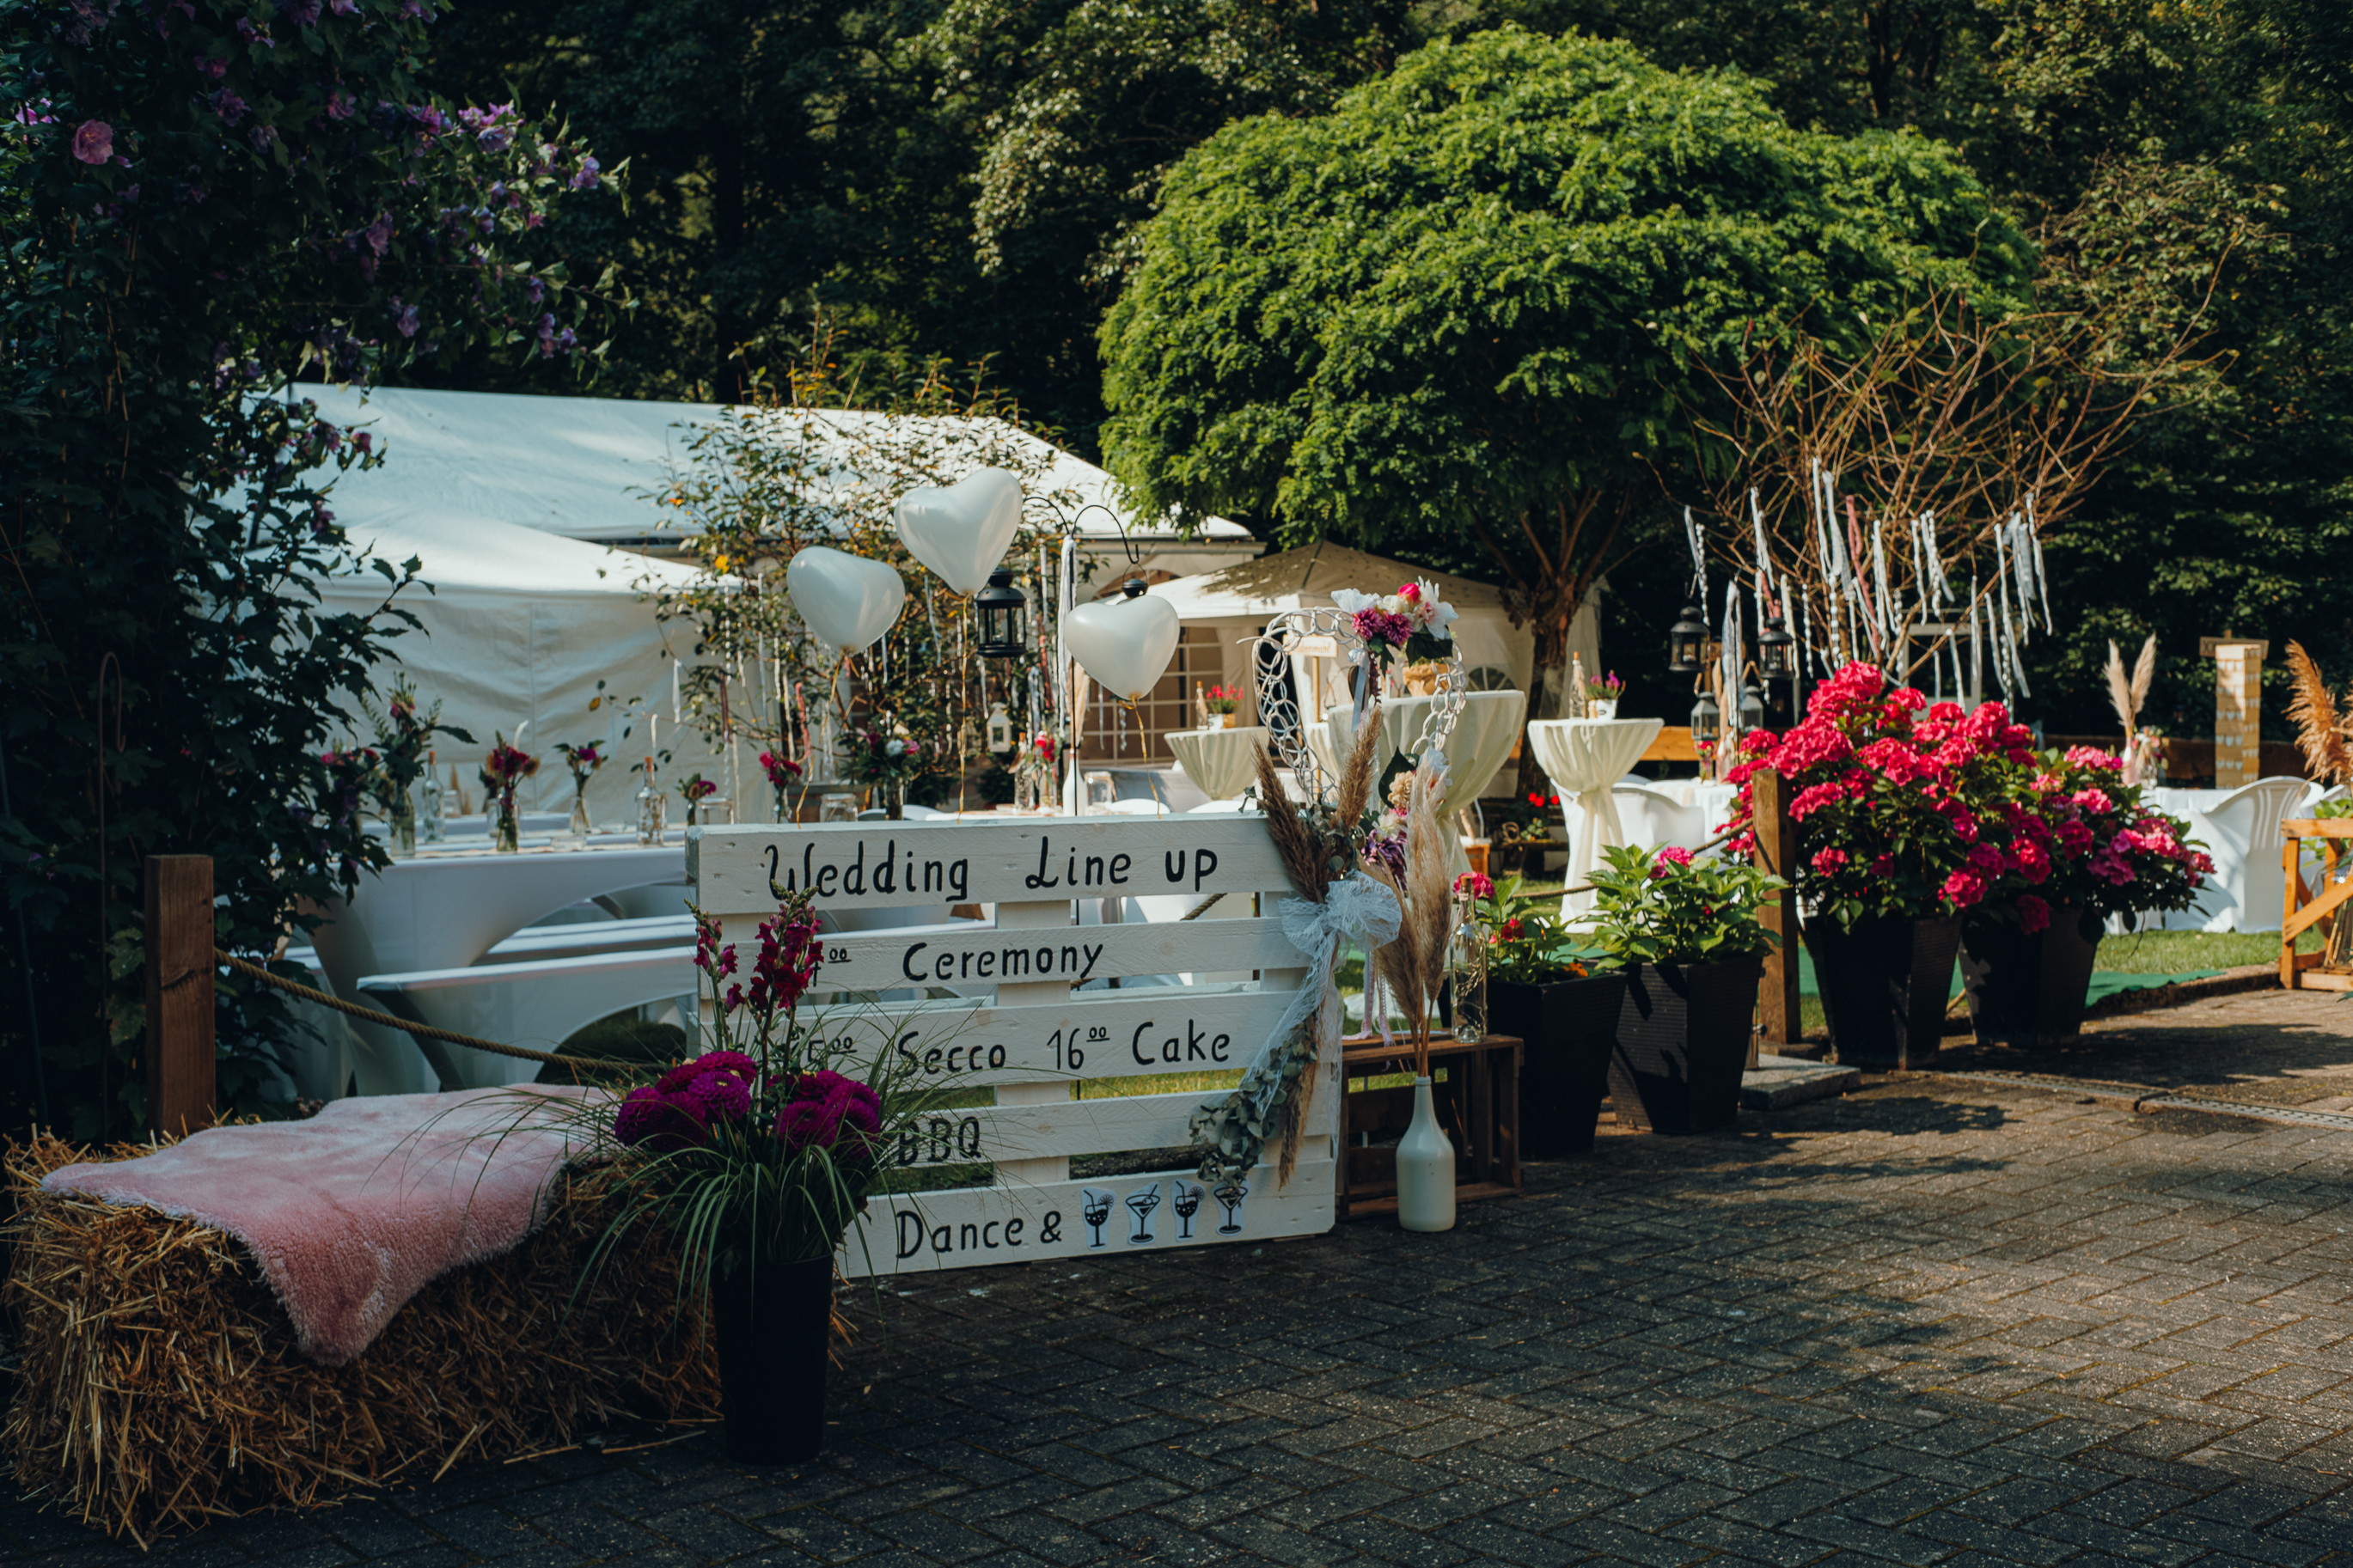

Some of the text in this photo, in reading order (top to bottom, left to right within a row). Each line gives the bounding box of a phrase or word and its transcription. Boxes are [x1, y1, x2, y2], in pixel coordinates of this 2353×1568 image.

[764, 835, 1219, 902] Wedding Line up
[902, 942, 1104, 982] Ceremony
[897, 1030, 1006, 1077] Secco
[1132, 1018, 1231, 1066] Cake
[897, 1115, 982, 1165] BBQ
[895, 1209, 1062, 1259] Dance &
